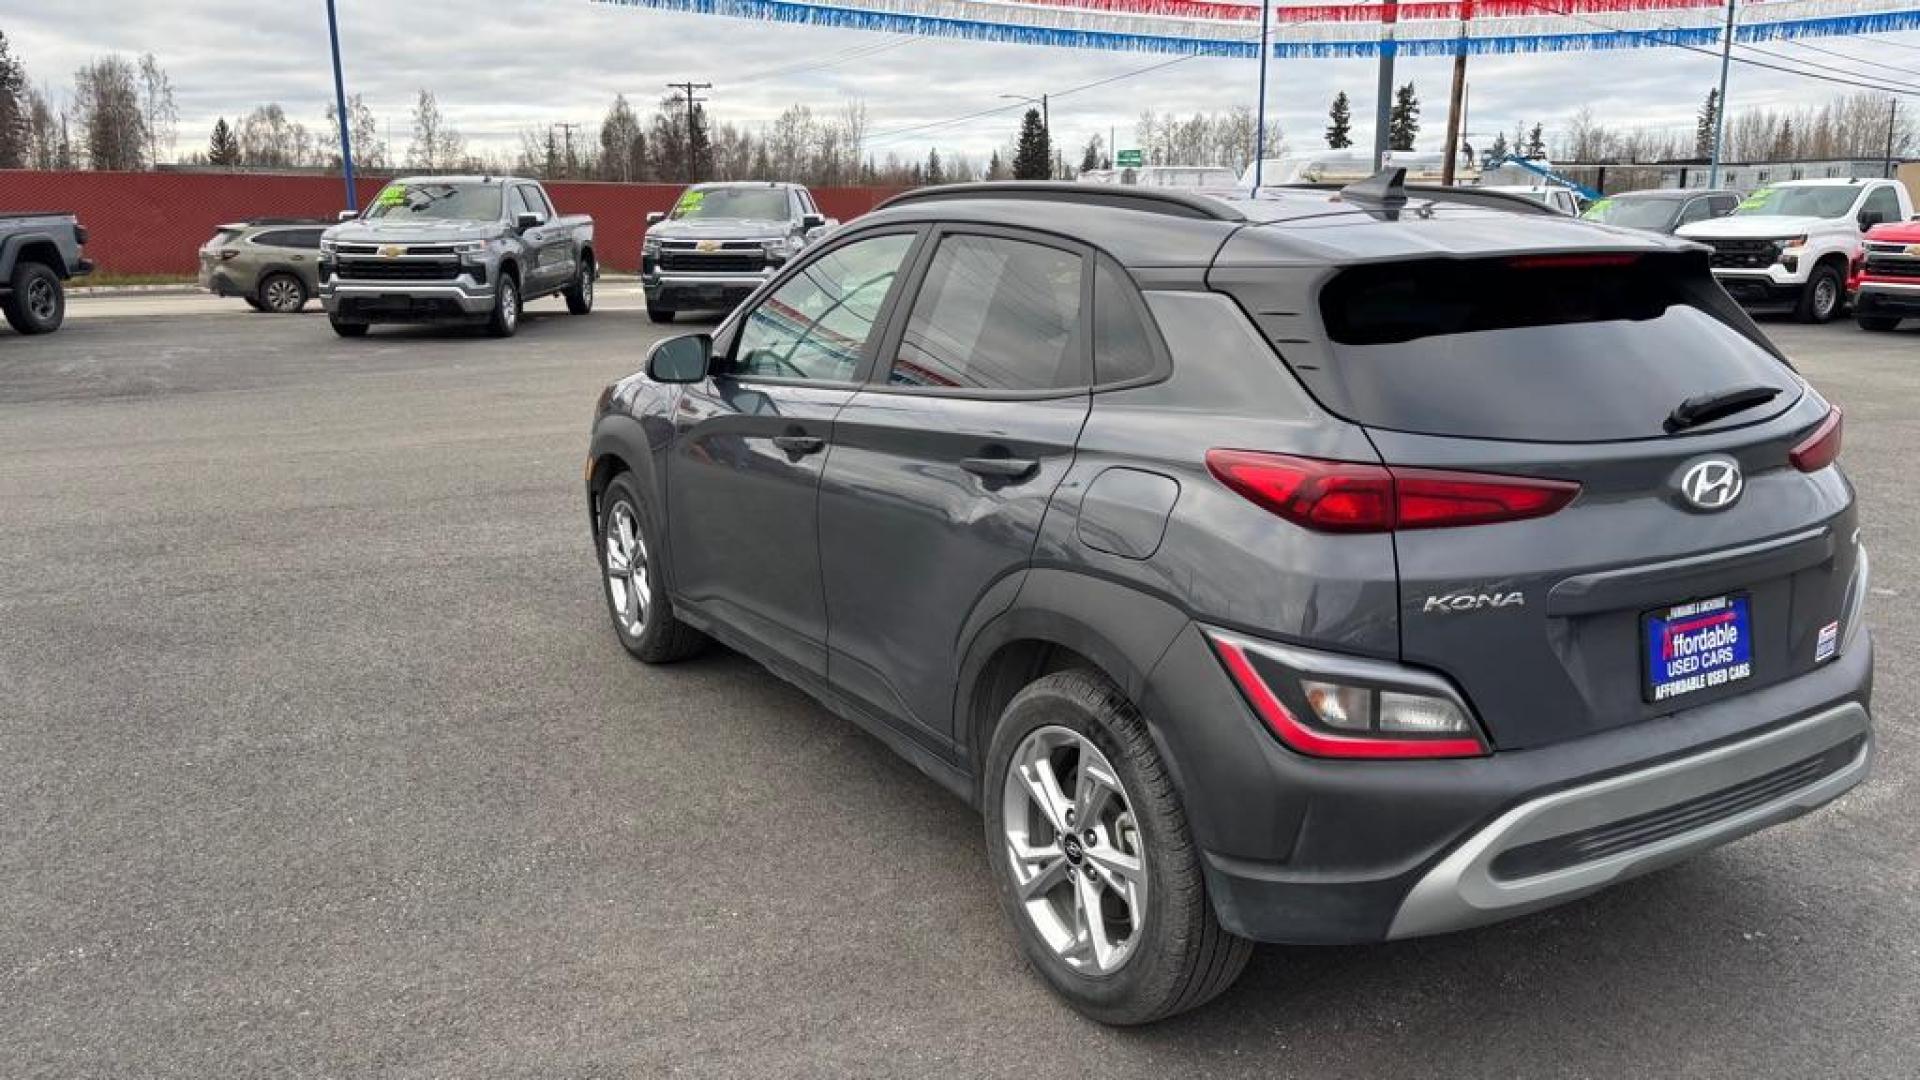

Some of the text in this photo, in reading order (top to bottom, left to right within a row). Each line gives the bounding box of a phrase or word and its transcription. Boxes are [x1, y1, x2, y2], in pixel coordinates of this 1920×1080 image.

[1423, 592, 1525, 614] KONA
[1663, 621, 1737, 660] Affordable
[1667, 647, 1733, 677] USED CARS
[1655, 663, 1750, 700] AFFORDABLE USED CARS
